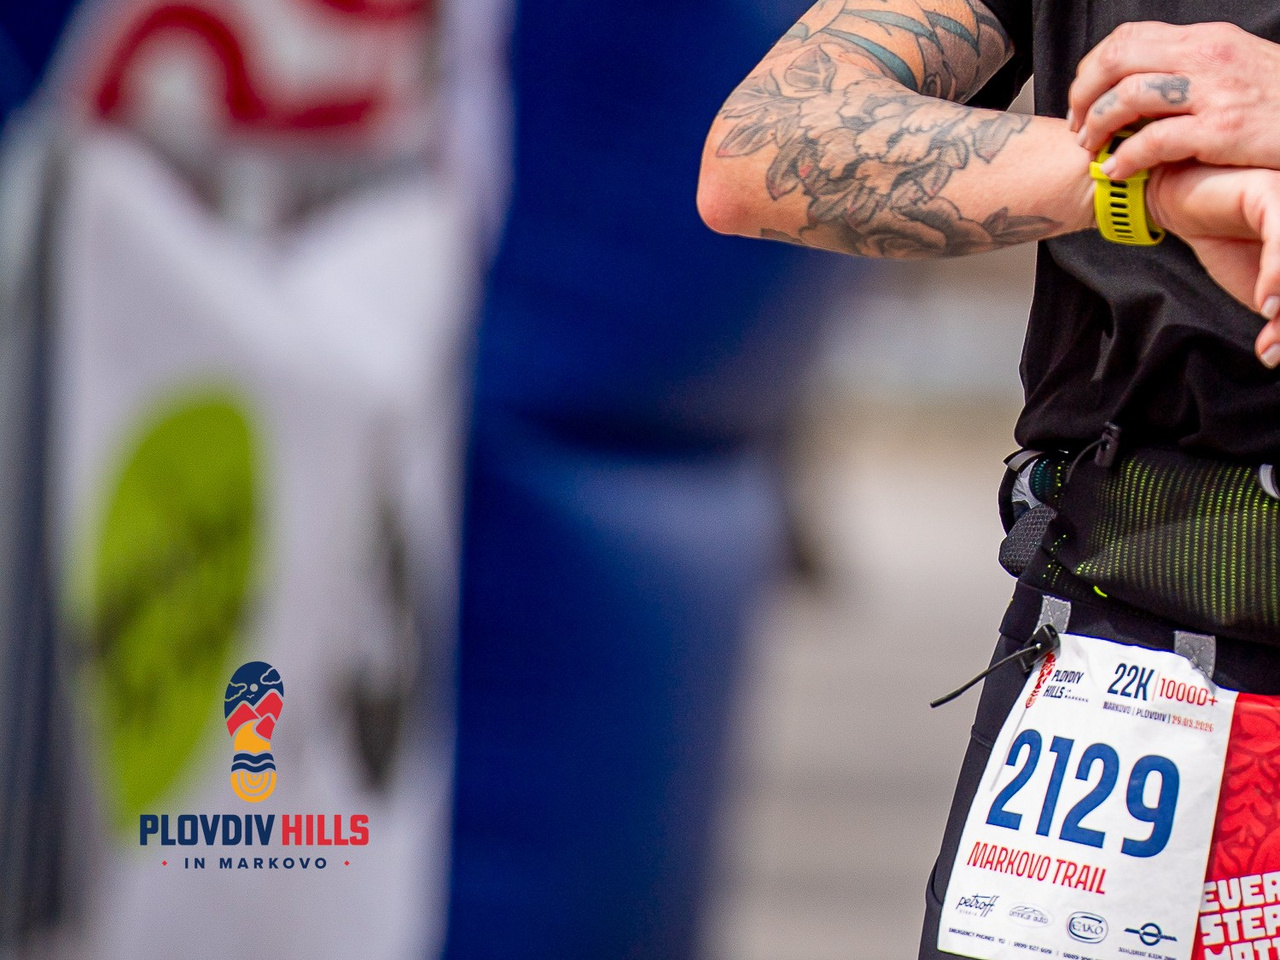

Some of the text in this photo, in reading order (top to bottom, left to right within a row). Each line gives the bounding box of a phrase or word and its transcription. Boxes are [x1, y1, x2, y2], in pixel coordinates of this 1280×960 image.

[1107, 662, 1155, 701] 22K
[985, 728, 1180, 859] 2129
[966, 841, 1108, 896] MARKOVO TRAIL
